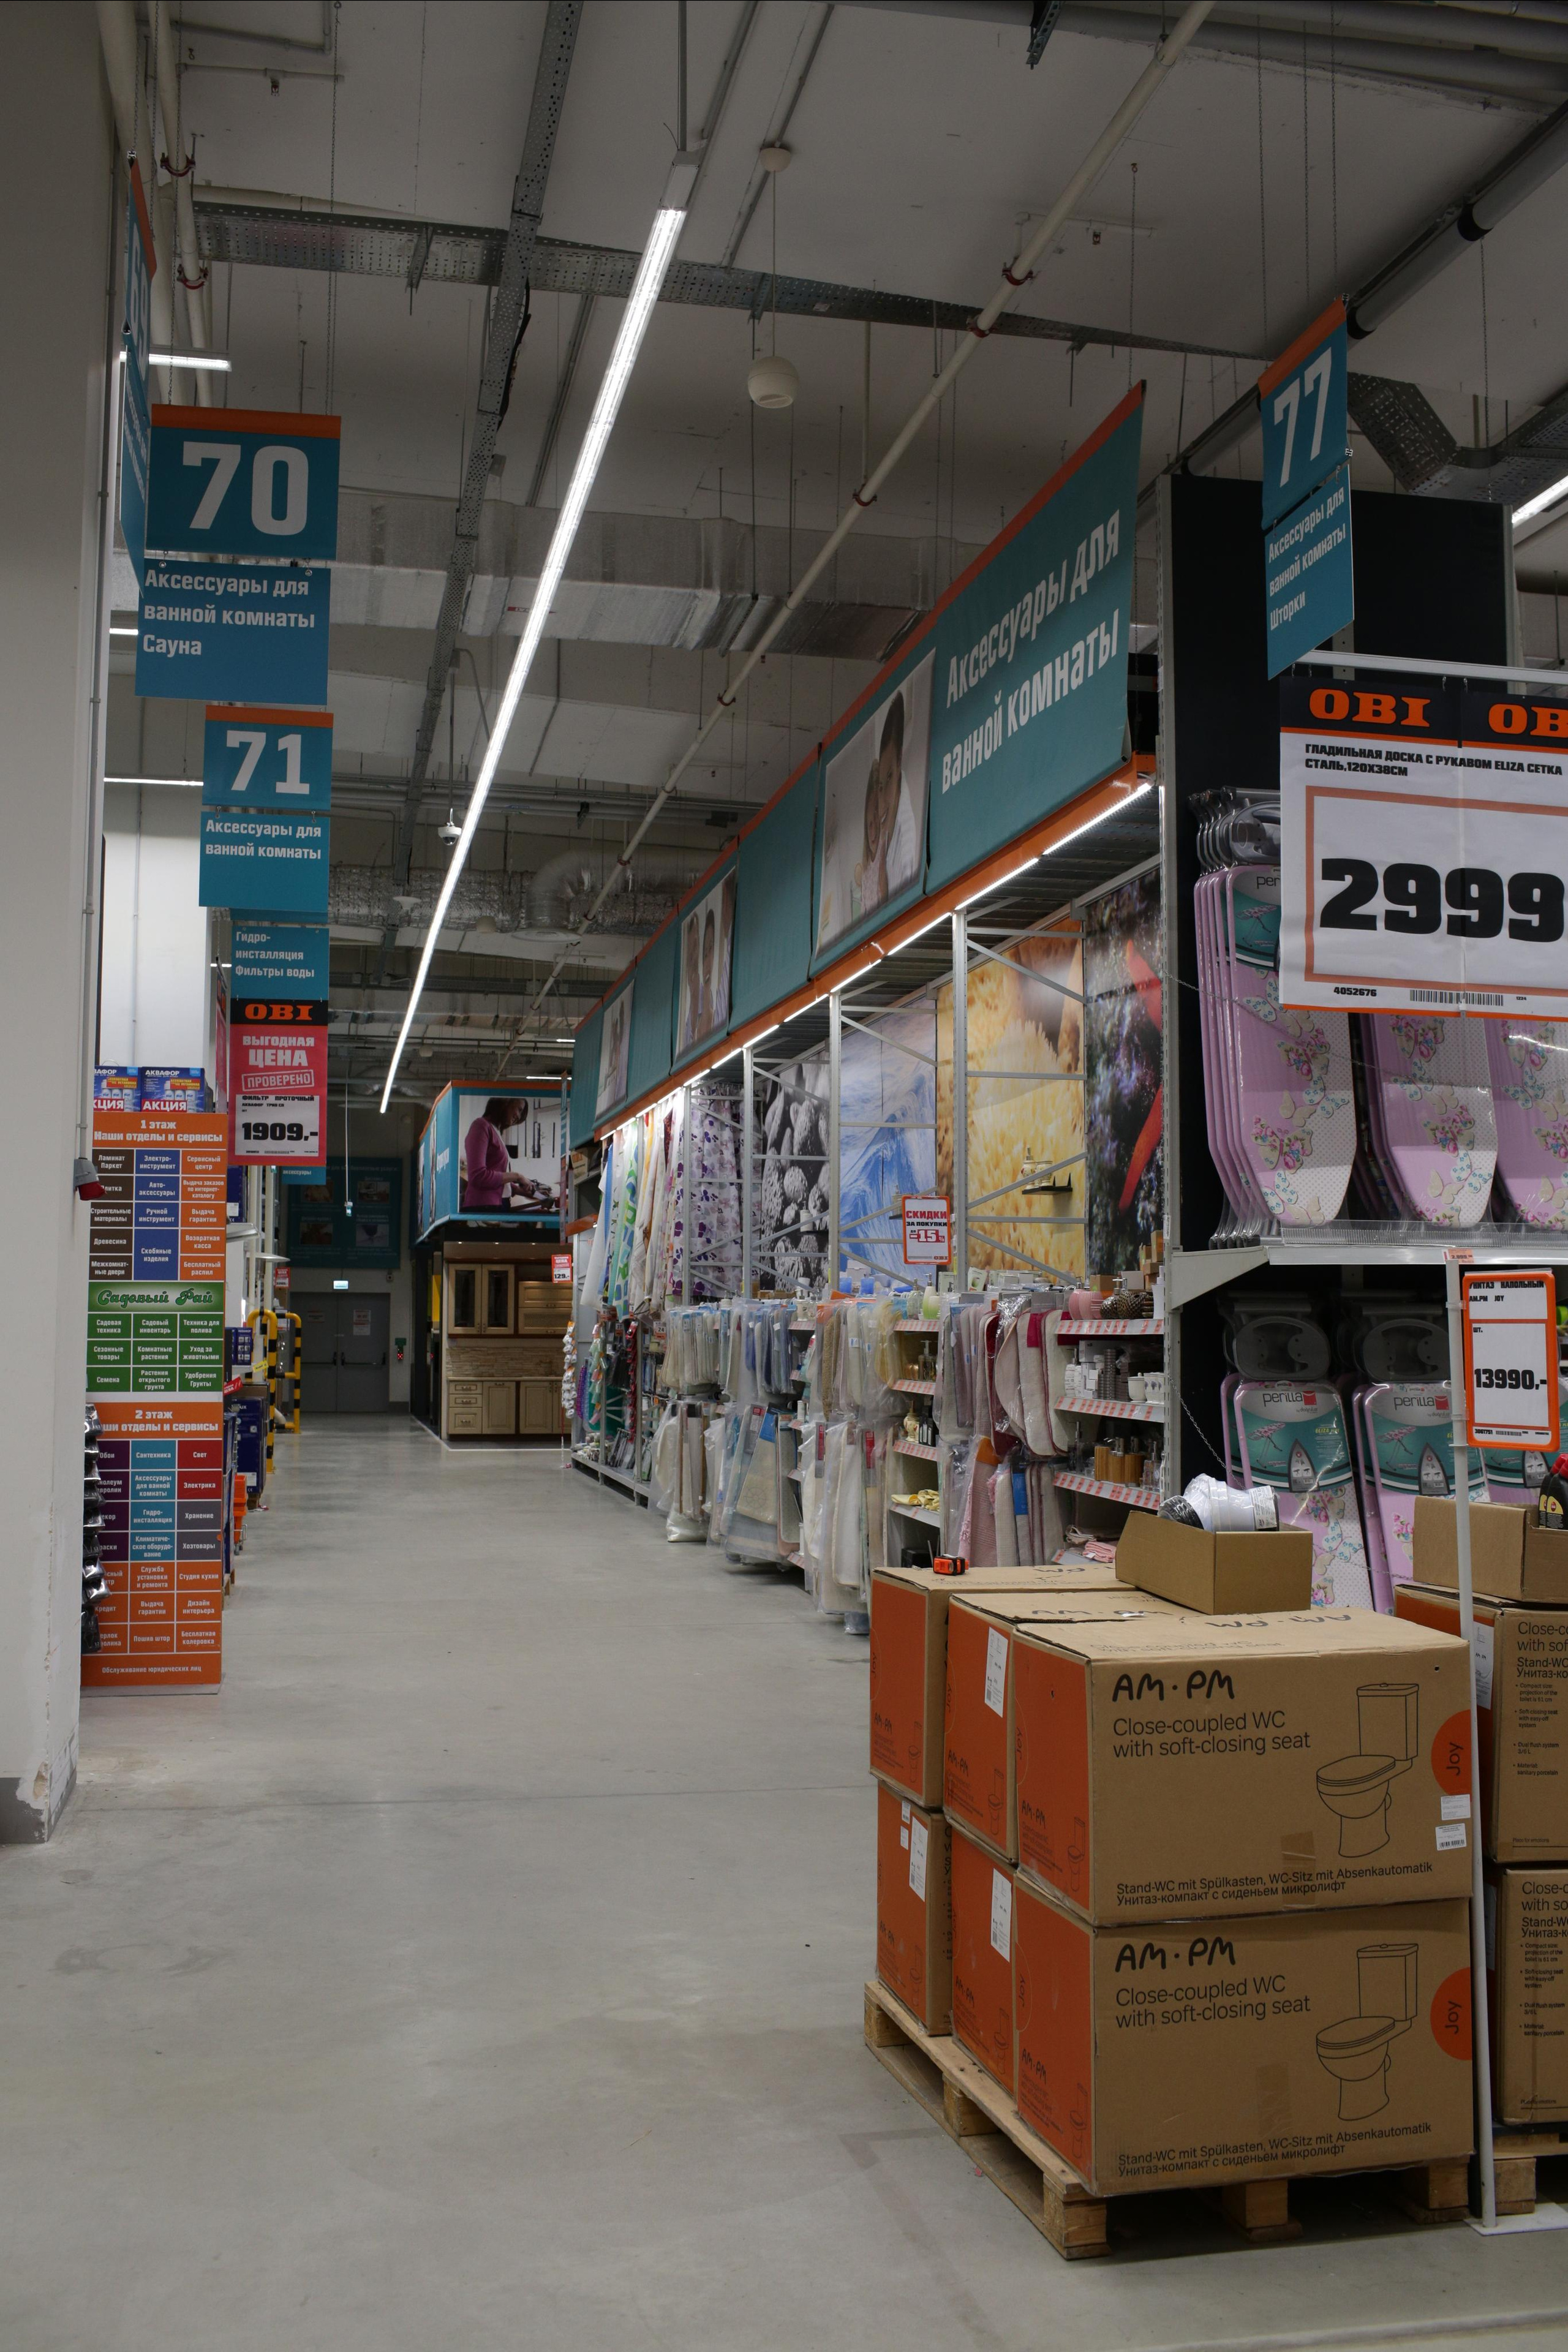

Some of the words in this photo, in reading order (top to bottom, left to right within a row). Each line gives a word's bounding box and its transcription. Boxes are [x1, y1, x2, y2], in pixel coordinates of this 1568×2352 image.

[1273, 347, 1332, 488] 77
[182, 441, 309, 535] 70
[1268, 507, 1324, 564] Аксессуары
[1326, 487, 1344, 516] для
[1270, 557, 1300, 597] ванной
[1303, 524, 1346, 568] комнаты
[145, 570, 268, 597] Аксессуары
[273, 579, 309, 597] для
[144, 605, 216, 624] ванной
[222, 610, 315, 628] комнаты
[947, 559, 1067, 709] Аксессуары
[1070, 509, 1119, 603] для
[1270, 590, 1306, 631] Шторки
[143, 635, 202, 658] Сауна
[941, 690, 1003, 794] ванной
[1008, 609, 1119, 738] комнаты
[1308, 688, 1431, 728] OBI
[227, 730, 309, 794] 71
[1305, 744, 1382, 760] ГЛАДИЛЬНАЯ
[1385, 750, 1423, 764] ДОСКА
[1427, 755, 1433, 764] С
[1436, 756, 1492, 769] РУКАВОМ
[1495, 761, 1524, 772] ELIZA
[1528, 763, 1562, 775] СЕТКА
[206, 820, 292, 837] Аксессуары
[296, 827, 321, 838] для
[206, 843, 254, 856] ванной
[258, 846, 321, 859] комнаты
[1320, 858, 1565, 943] 2999
[236, 932, 270, 943] Гидро-
[236, 951, 303, 960] инсталляция
[236, 965, 283, 978] Фильтры
[287, 968, 314, 978] воды
[1333, 987, 1377, 997] 4052676
[245, 1004, 313, 1020] OBI
[243, 1036, 314, 1047] ВЫГОДНАЯ
[249, 1049, 308, 1068] ЦЕНА
[247, 1073, 311, 1088] ПРОВЕРЕНО
[143, 1101, 186, 1112] АКЦИЯ
[149, 1120, 176, 1129] этаж
[243, 1123, 318, 1140] 1909,-
[178, 1134, 222, 1142] сервисы
[907, 1211, 946, 1219] СКИДКИ
[97, 1290, 168, 1308] Садовый
[176, 1288, 213, 1305] Рай
[1474, 1369, 1547, 1390] 13990,-
[1263, 1392, 1303, 1407] perilla
[1394, 1397, 1434, 1410] perilla
[121, 1423, 160, 1432] отделы
[173, 1423, 218, 1432] сервисы
[1517, 1639, 1544, 1651] with
[1114, 1713, 1246, 1738] Close-coupled
[1252, 1710, 1285, 1728] WC
[1114, 1736, 1153, 1758] with
[1159, 1736, 1266, 1756] soft-closing
[1272, 1732, 1311, 1749] seat
[1447, 1742, 1463, 1776] Joy
[1117, 1882, 1175, 1894] Stand-WC
[1178, 1879, 1197, 1891] mit
[1200, 1874, 1267, 1891] Spülkasten,
[1268, 1871, 1313, 1884] WC-Sitz
[1316, 1868, 1334, 1880] mit
[1336, 1861, 1433, 1879] Absenkautomatik
[1117, 1892, 1209, 1906] Унитаз-компакт
[1222, 1887, 1278, 1899] сиденьем
[1282, 1881, 1345, 1896] микролифт
[1522, 1899, 1549, 1911] with
[1116, 1979, 1246, 2007] Close-coupled
[1253, 1975, 1285, 1994] WC
[1116, 2007, 1155, 2028] with
[1161, 2001, 1266, 2024] soft-closing
[1272, 1996, 1310, 2013] seat
[1446, 2000, 1462, 2034] Joy
[1119, 2151, 1175, 2166] Stand-WC
[1179, 2148, 1196, 2160] mit
[1200, 2143, 1265, 2158] Spülkasten,
[1268, 2138, 1312, 2150] WC-Sitz
[1315, 2134, 1333, 2146] mit
[1336, 2124, 1431, 2143] Absenkautomatik
[1119, 2160, 1209, 2177] Унитаз-компакт
[1222, 2154, 1278, 2168] сиденьем
[1281, 2146, 1345, 2162] микролифт
